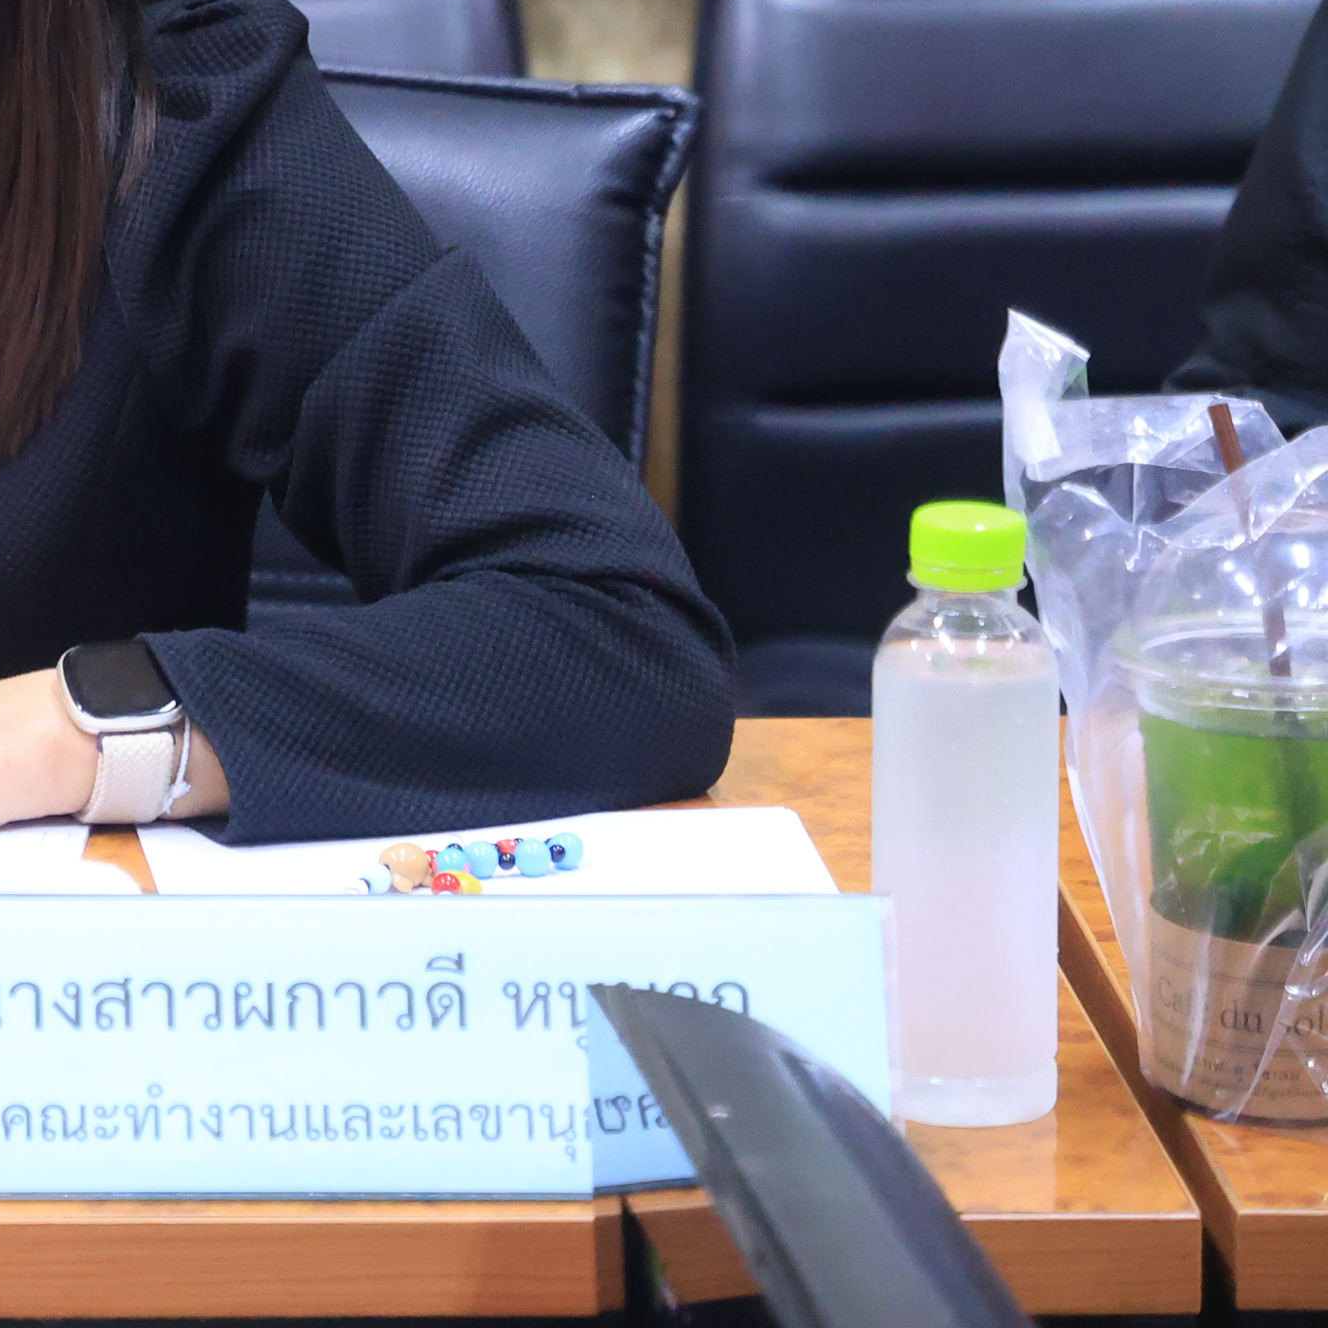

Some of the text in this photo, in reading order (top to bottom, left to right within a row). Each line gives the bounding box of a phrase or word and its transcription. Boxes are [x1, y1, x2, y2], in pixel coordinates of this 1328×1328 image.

[1219, 999, 1263, 1034] du
[1, 1082, 594, 1164] คณะทำงานและเลขานุ
